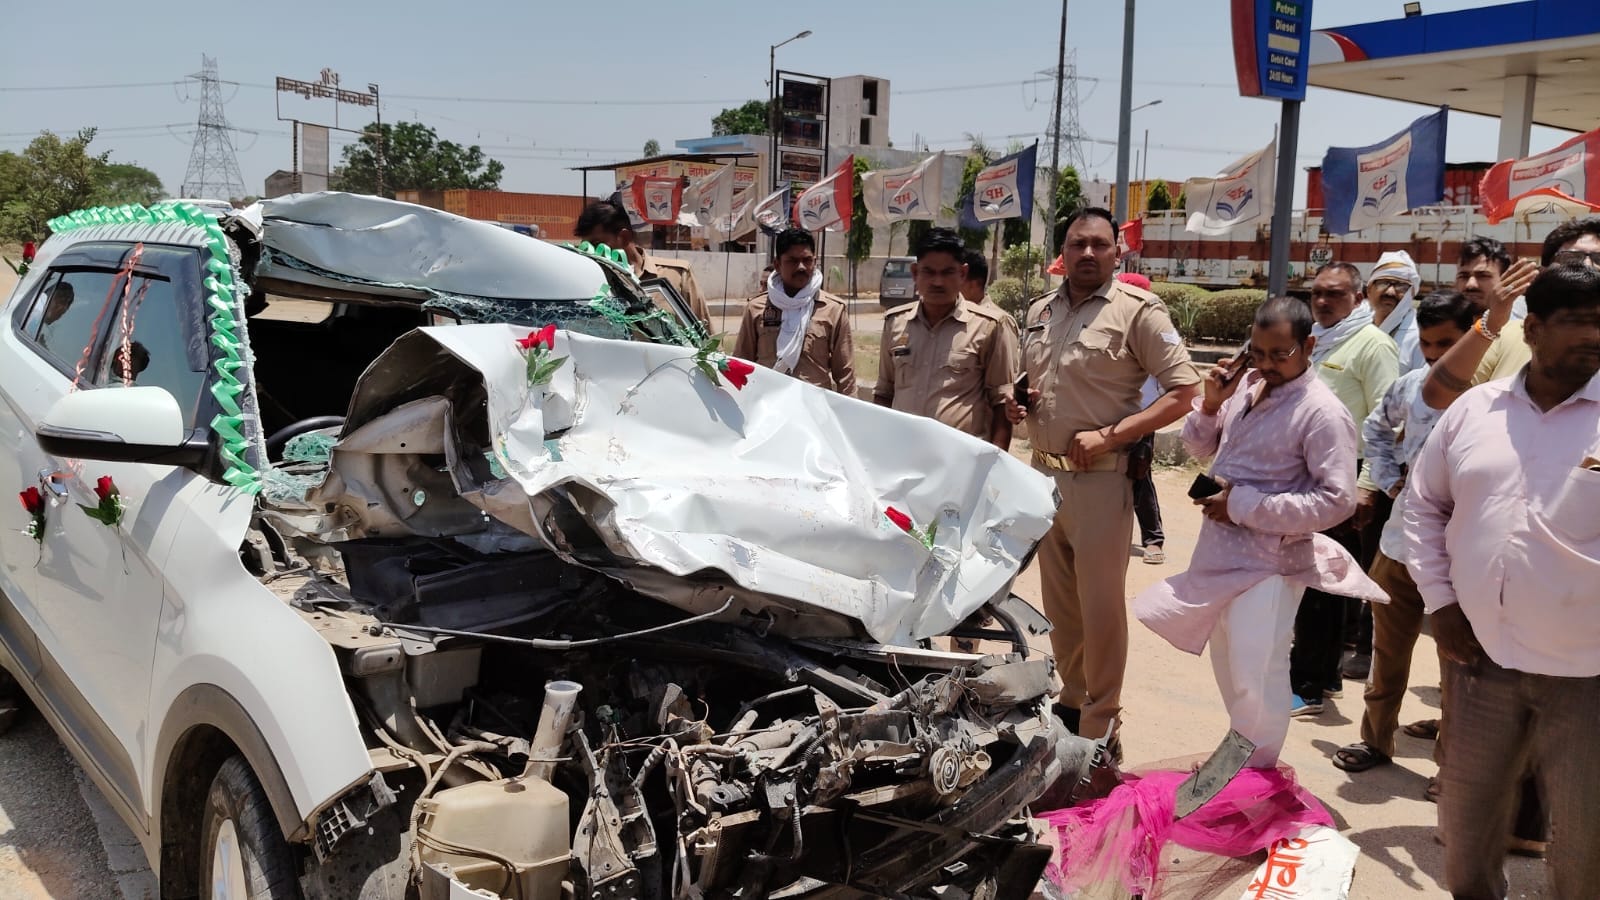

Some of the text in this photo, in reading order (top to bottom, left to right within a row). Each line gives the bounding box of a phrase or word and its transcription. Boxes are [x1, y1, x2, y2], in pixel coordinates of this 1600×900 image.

[1275, 1, 1297, 17] Petrol
[1275, 18, 1296, 33] Diesel
[1270, 53, 1296, 67] Debit Card
